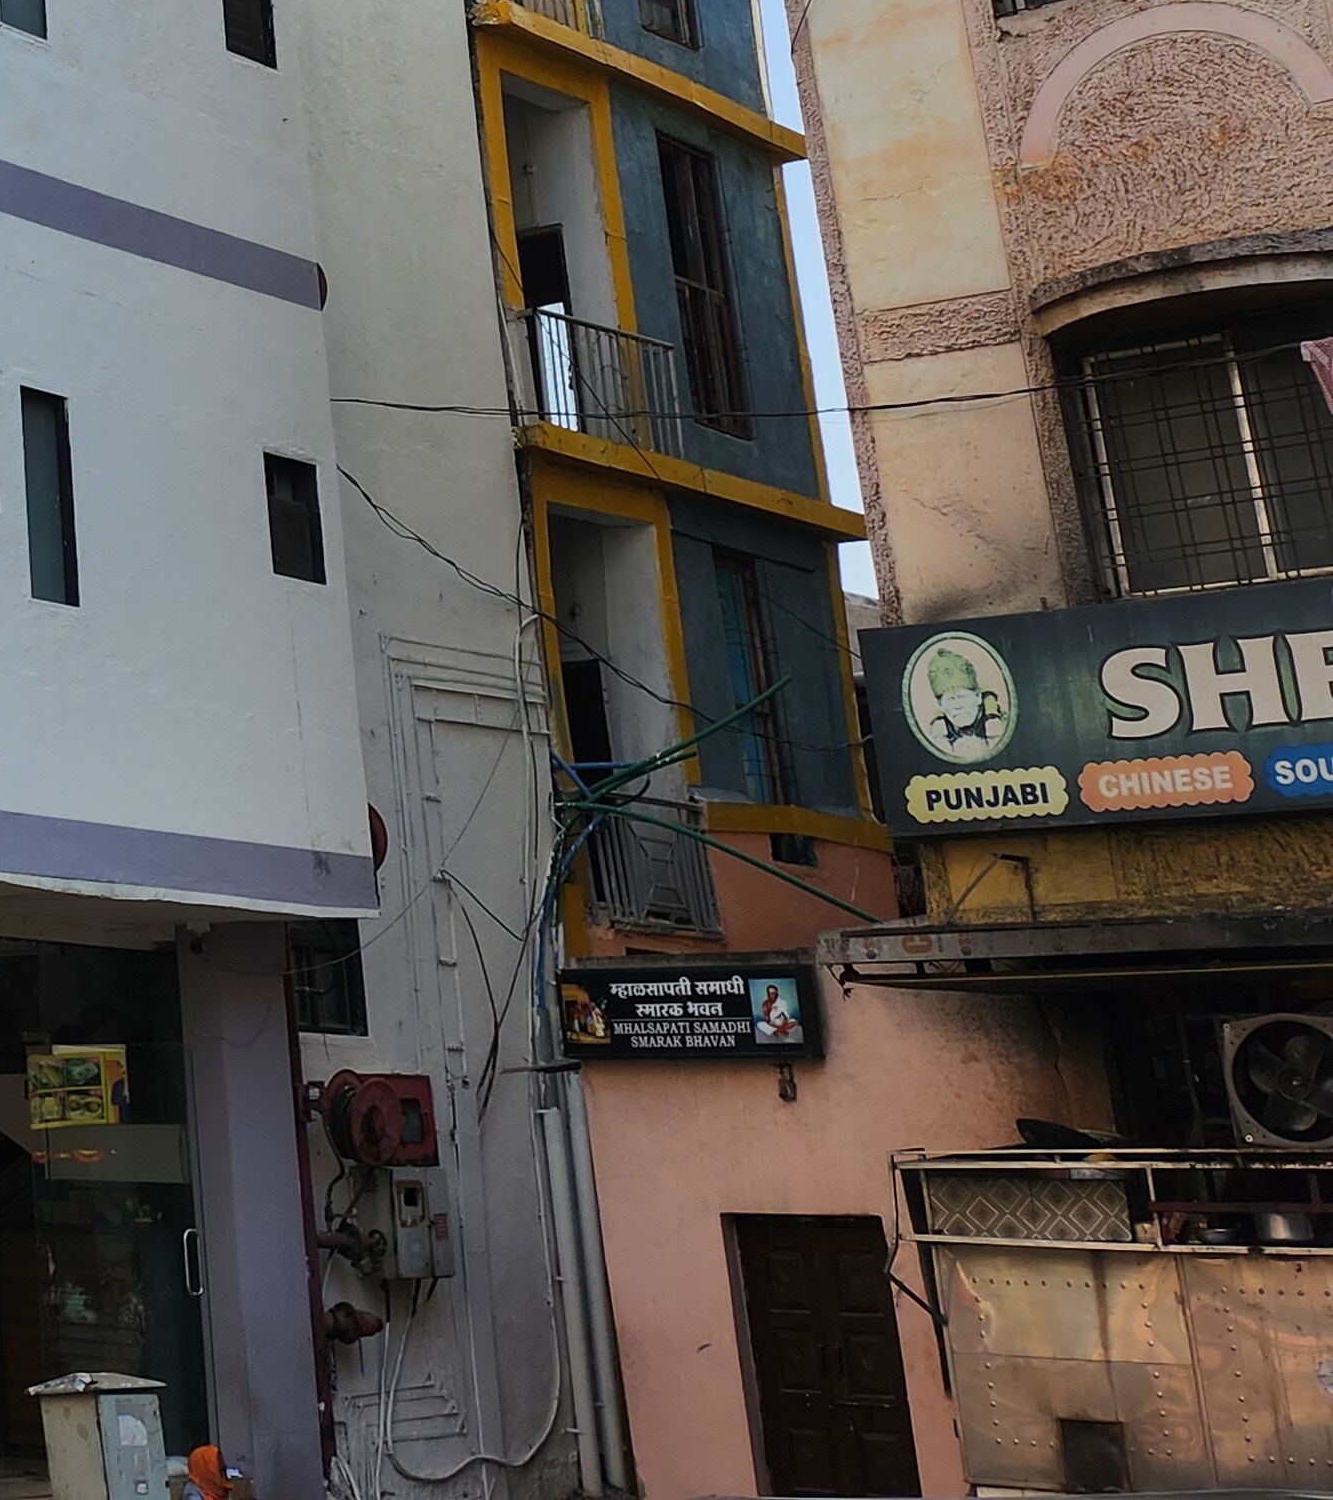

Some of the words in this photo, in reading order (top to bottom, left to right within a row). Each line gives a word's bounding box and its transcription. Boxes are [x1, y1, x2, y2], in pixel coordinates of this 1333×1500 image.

[925, 781, 1049, 812] PUNJABI
[1097, 764, 1233, 799] CHINESE
[609, 976, 692, 999] म्हाळसापती
[694, 975, 746, 996] समाधी
[635, 1001, 683, 1018] स्मारक
[686, 1001, 724, 1017] भवन
[613, 1022, 691, 1035] MHALSAPATI
[693, 1021, 751, 1034] SAMADHI
[630, 1035, 683, 1048] SMARAK
[685, 1034, 736, 1048] BHAVAN
